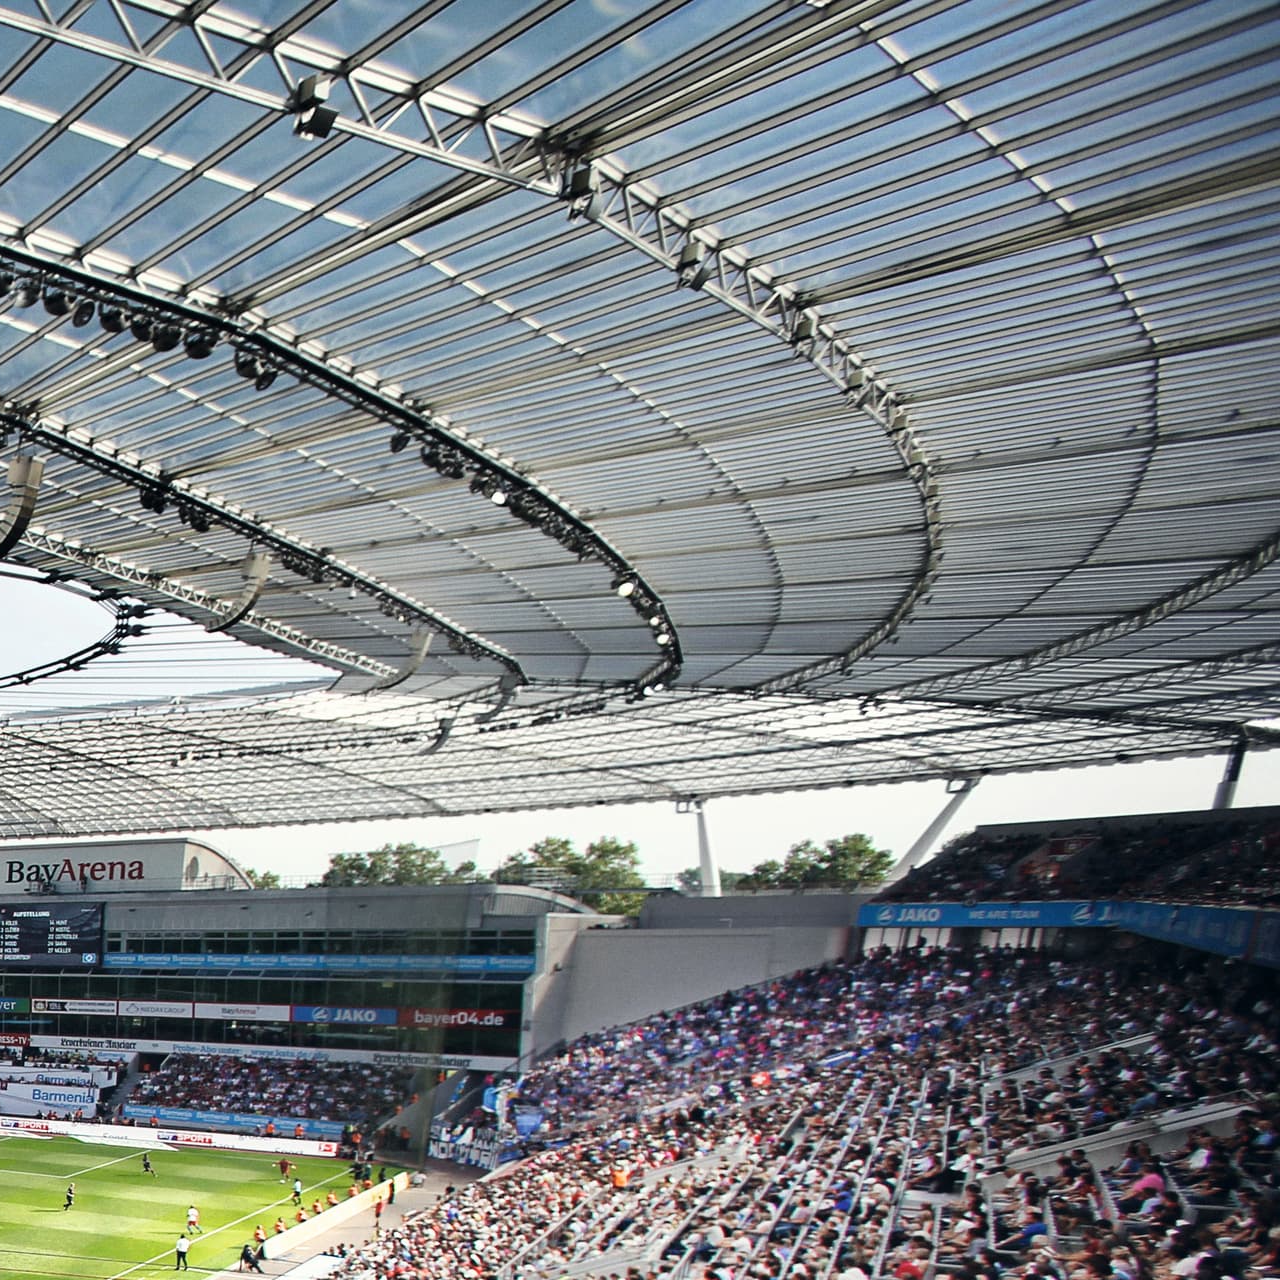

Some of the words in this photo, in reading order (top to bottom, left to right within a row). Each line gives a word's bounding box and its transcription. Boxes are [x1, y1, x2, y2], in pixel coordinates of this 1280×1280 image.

[5, 858, 144, 884] BayArena
[896, 907, 940, 923] JAKO
[333, 1009, 377, 1022] JAKO
[414, 1010, 505, 1026] bayer04.de
[32, 1088, 95, 1104] Barmenia
[19, 1120, 49, 1131] SPORT
[177, 1133, 213, 1144] SPORT
